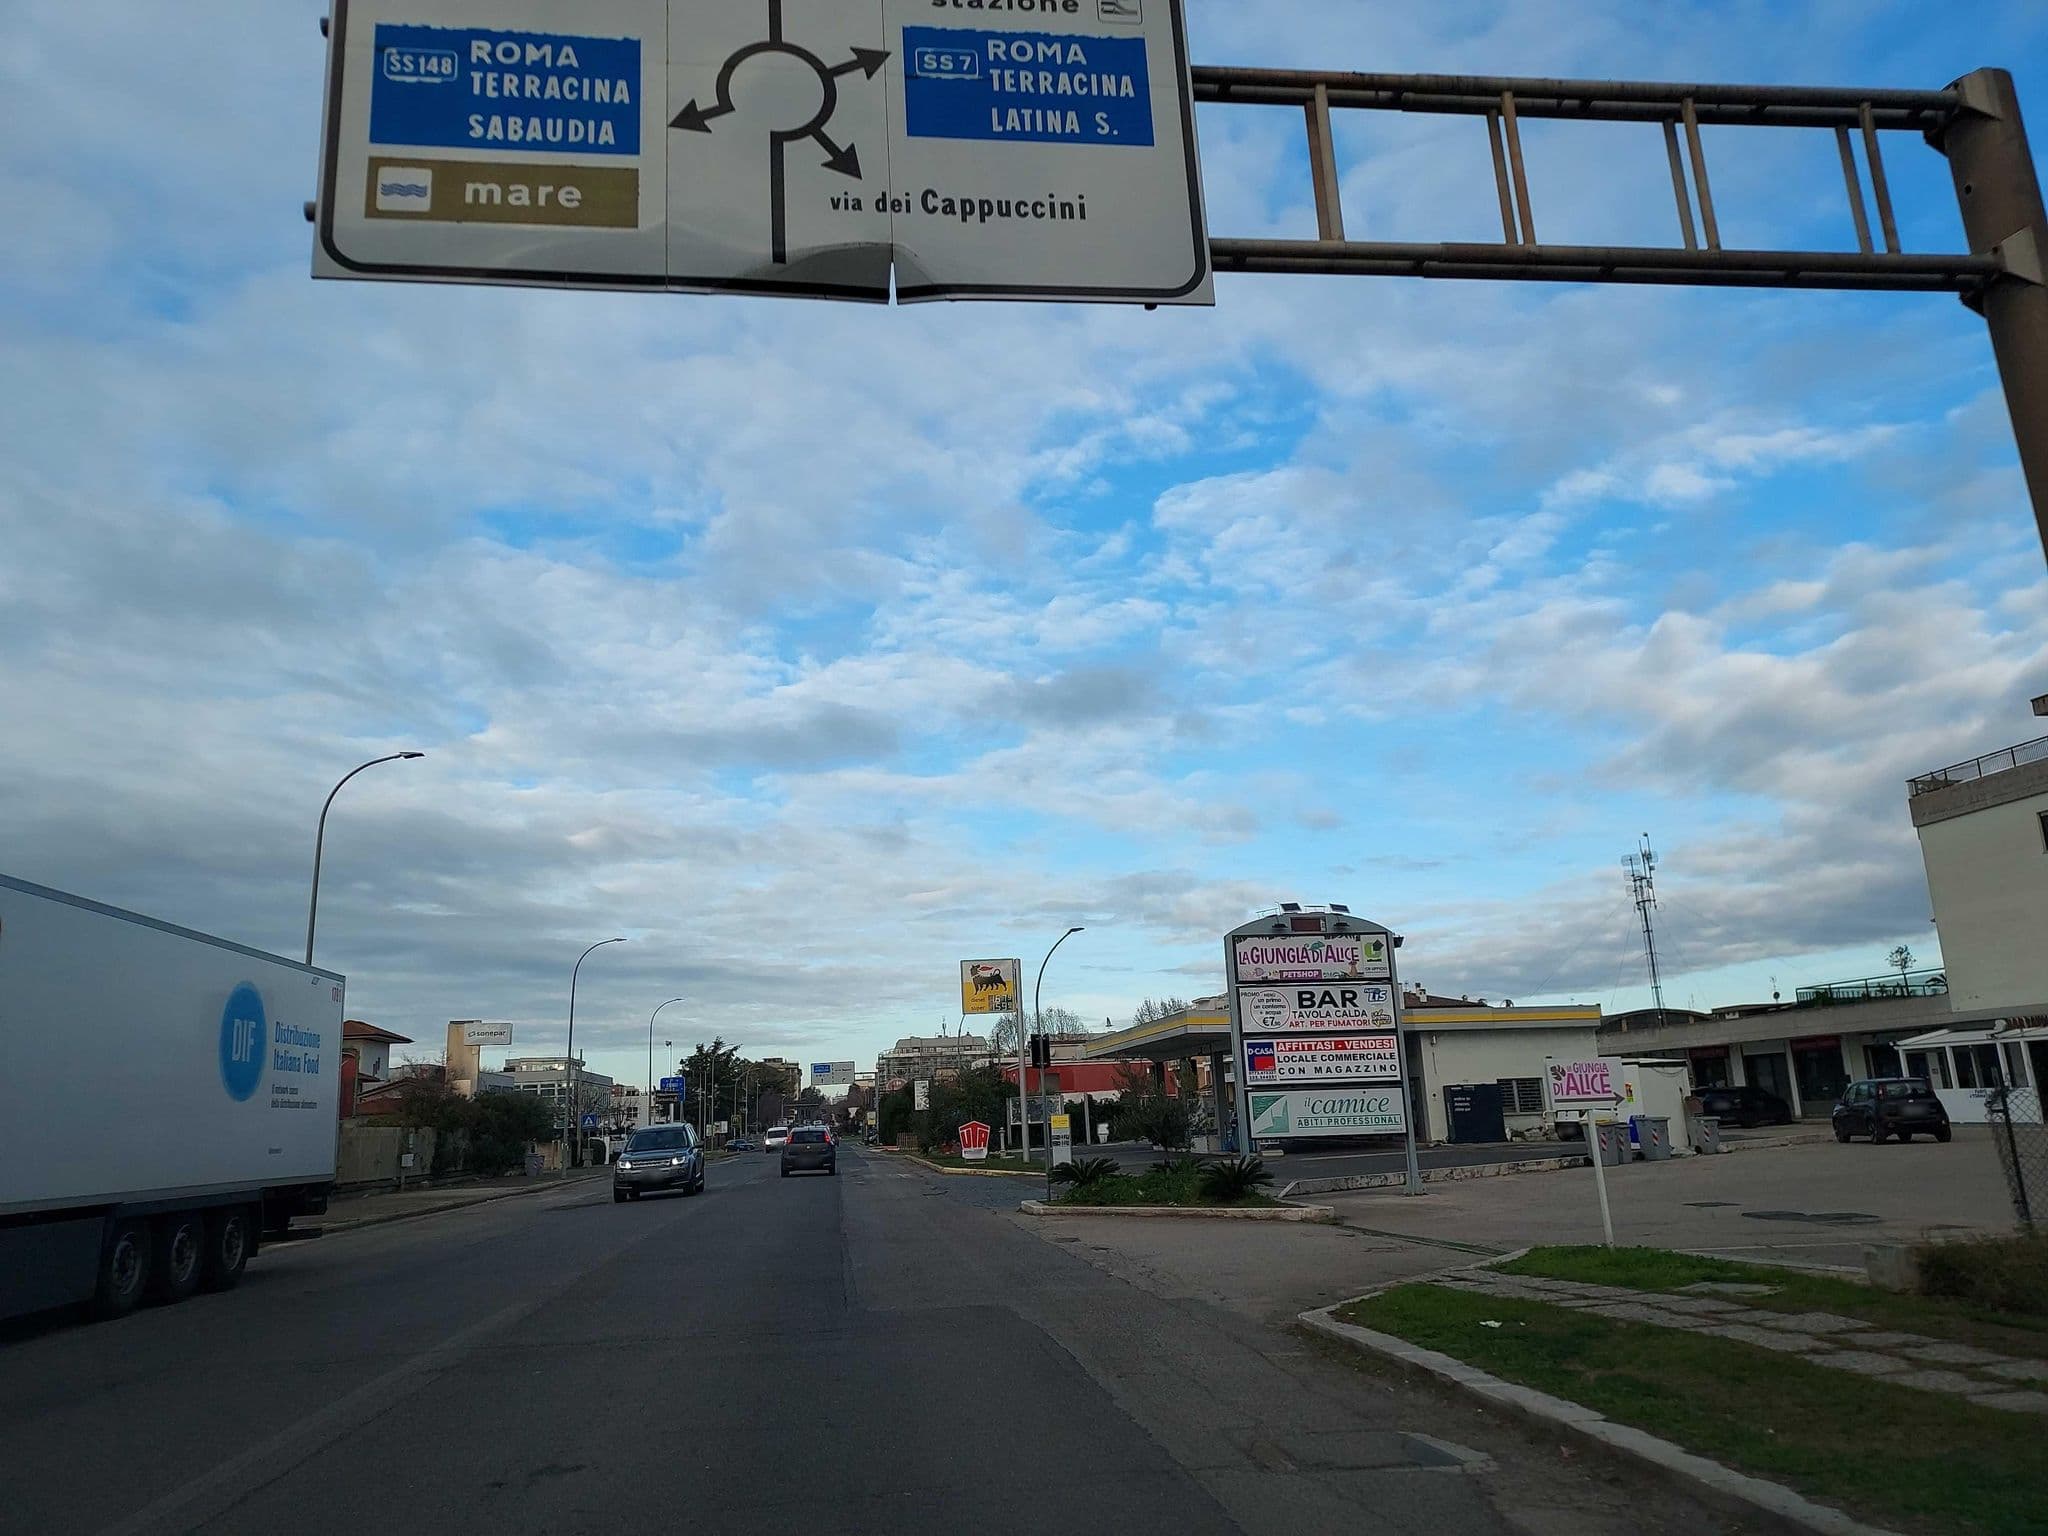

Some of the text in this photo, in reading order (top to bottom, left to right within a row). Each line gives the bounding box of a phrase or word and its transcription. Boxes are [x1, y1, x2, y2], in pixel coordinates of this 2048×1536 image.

[470, 40, 580, 69] ROMA
[922, 53, 972, 72] SS 7
[987, 39, 1087, 66] ROMA
[390, 53, 453, 75] SS 148
[470, 70, 631, 105] TERRACINA
[989, 69, 1136, 99] TERRACINA
[468, 113, 616, 146] SABAUDIA
[991, 106, 1119, 137] LATINA S.
[464, 180, 583, 210] mare
[829, 187, 1088, 223] via dei Cappuccini
[1250, 946, 1311, 965] GIUNGLA
[1324, 944, 1360, 964] ALICE
[1282, 970, 1319, 978] PETSHOP
[1297, 989, 1360, 1009] BAR
[1288, 1019, 1371, 1028] ART. PER FUMATORI
[1291, 1009, 1368, 1019] TAVOLA CALDA
[231, 1018, 257, 1063] DIF
[274, 1020, 321, 1049] Distribuzione
[1277, 1041, 1335, 1051] AFFITTASI
[1344, 1039, 1394, 1050] VENDESI
[273, 1048, 320, 1074] Italiana Food
[1277, 1052, 1396, 1064] LOCALE COMMERCIALE
[1572, 1062, 1609, 1074] GIUNGLA
[1278, 1066, 1306, 1076] CON
[1314, 1063, 1397, 1075] MAGAZZINO
[1552, 1082, 1564, 1097] DI
[1566, 1073, 1612, 1096] ALICE
[1311, 1097, 1390, 1115] camice
[1297, 1116, 1402, 1127] ABITI PROFESSIONALI
